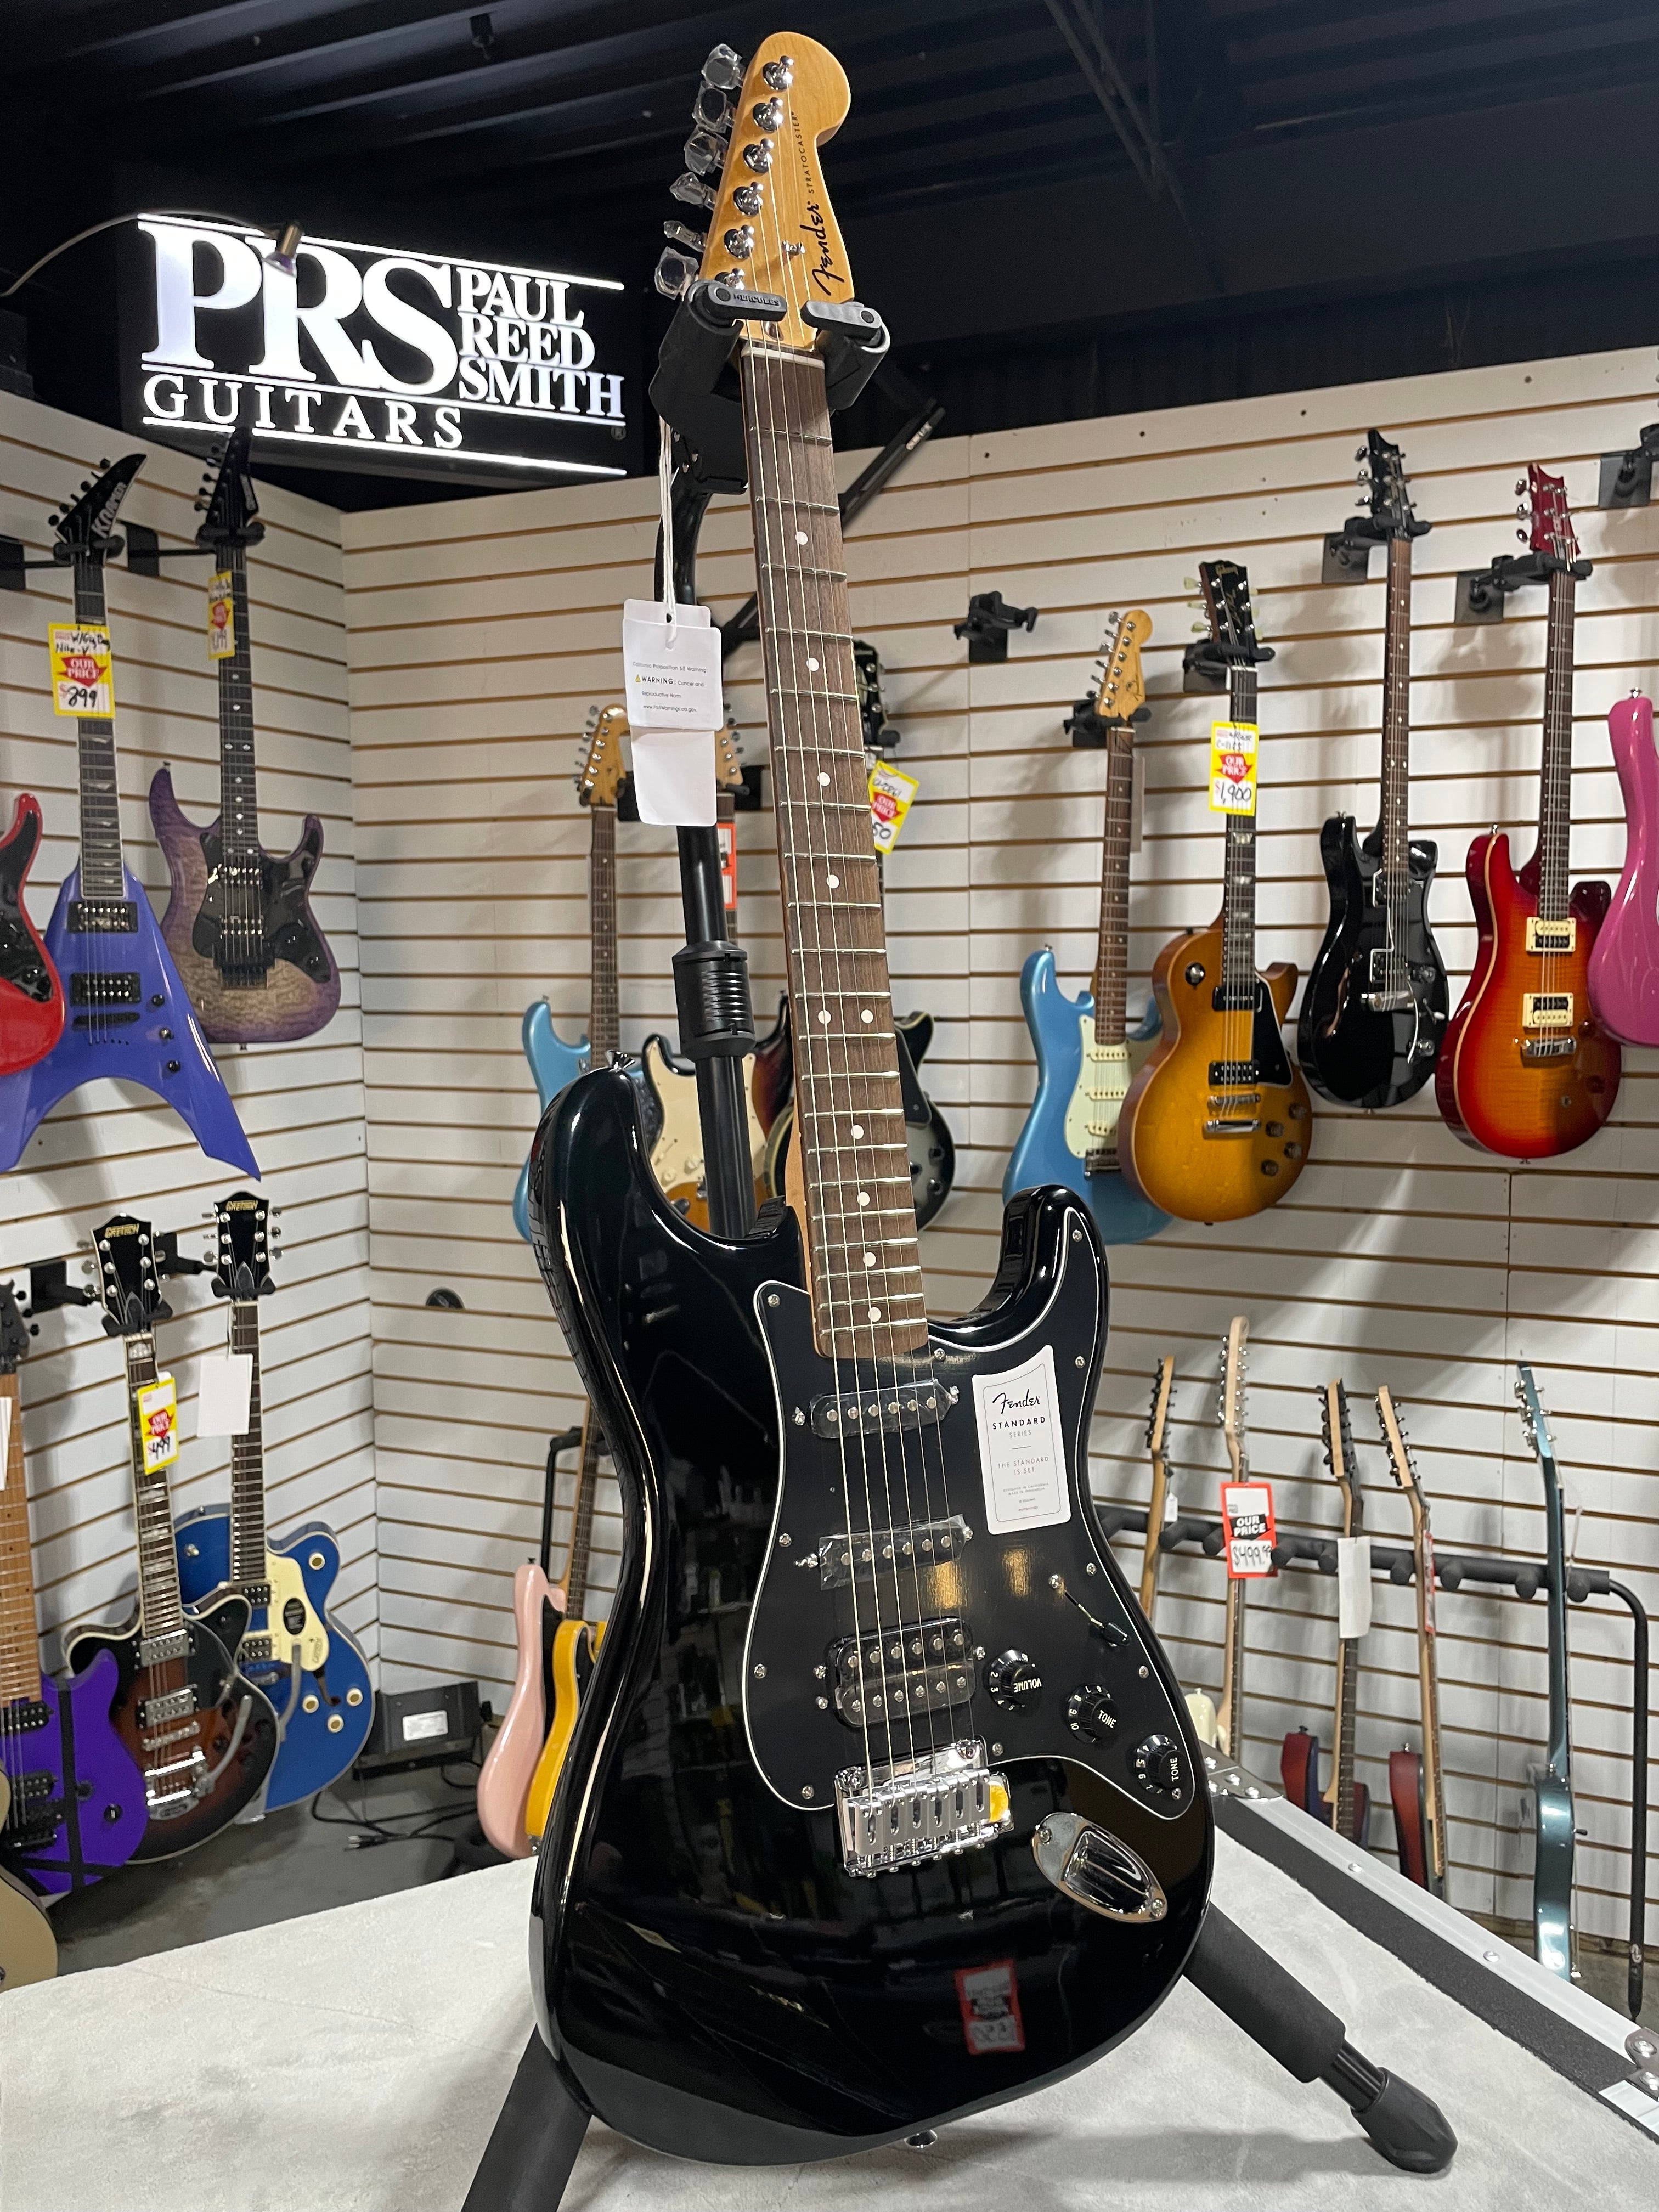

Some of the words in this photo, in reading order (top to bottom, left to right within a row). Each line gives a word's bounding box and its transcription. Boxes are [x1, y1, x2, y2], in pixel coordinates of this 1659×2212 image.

[799, 204, 845, 296] Fender
[456, 266, 584, 328] PAUL
[733, 293, 780, 306] HERCULES
[138, 222, 458, 395] PRS
[458, 312, 595, 369] REED
[459, 357, 624, 418] SMITH
[144, 374, 462, 449] GUITARS
[70, 658, 95, 668] OUR
[1225, 755, 1244, 766] OUR
[992, 1389, 1041, 1414] Fender
[992, 1416, 1046, 1430] STANDARD
[1009, 1430, 1031, 1438] SERIES
[1013, 1457, 1049, 1466] STANDARD
[1234, 1523, 1266, 1537] PRICE
[1236, 1516, 1260, 1527] OUR
[1013, 1678, 1042, 1693] VOLUME
[1098, 1709, 1116, 1729] TONE
[1170, 1757, 1179, 1782] TONE
